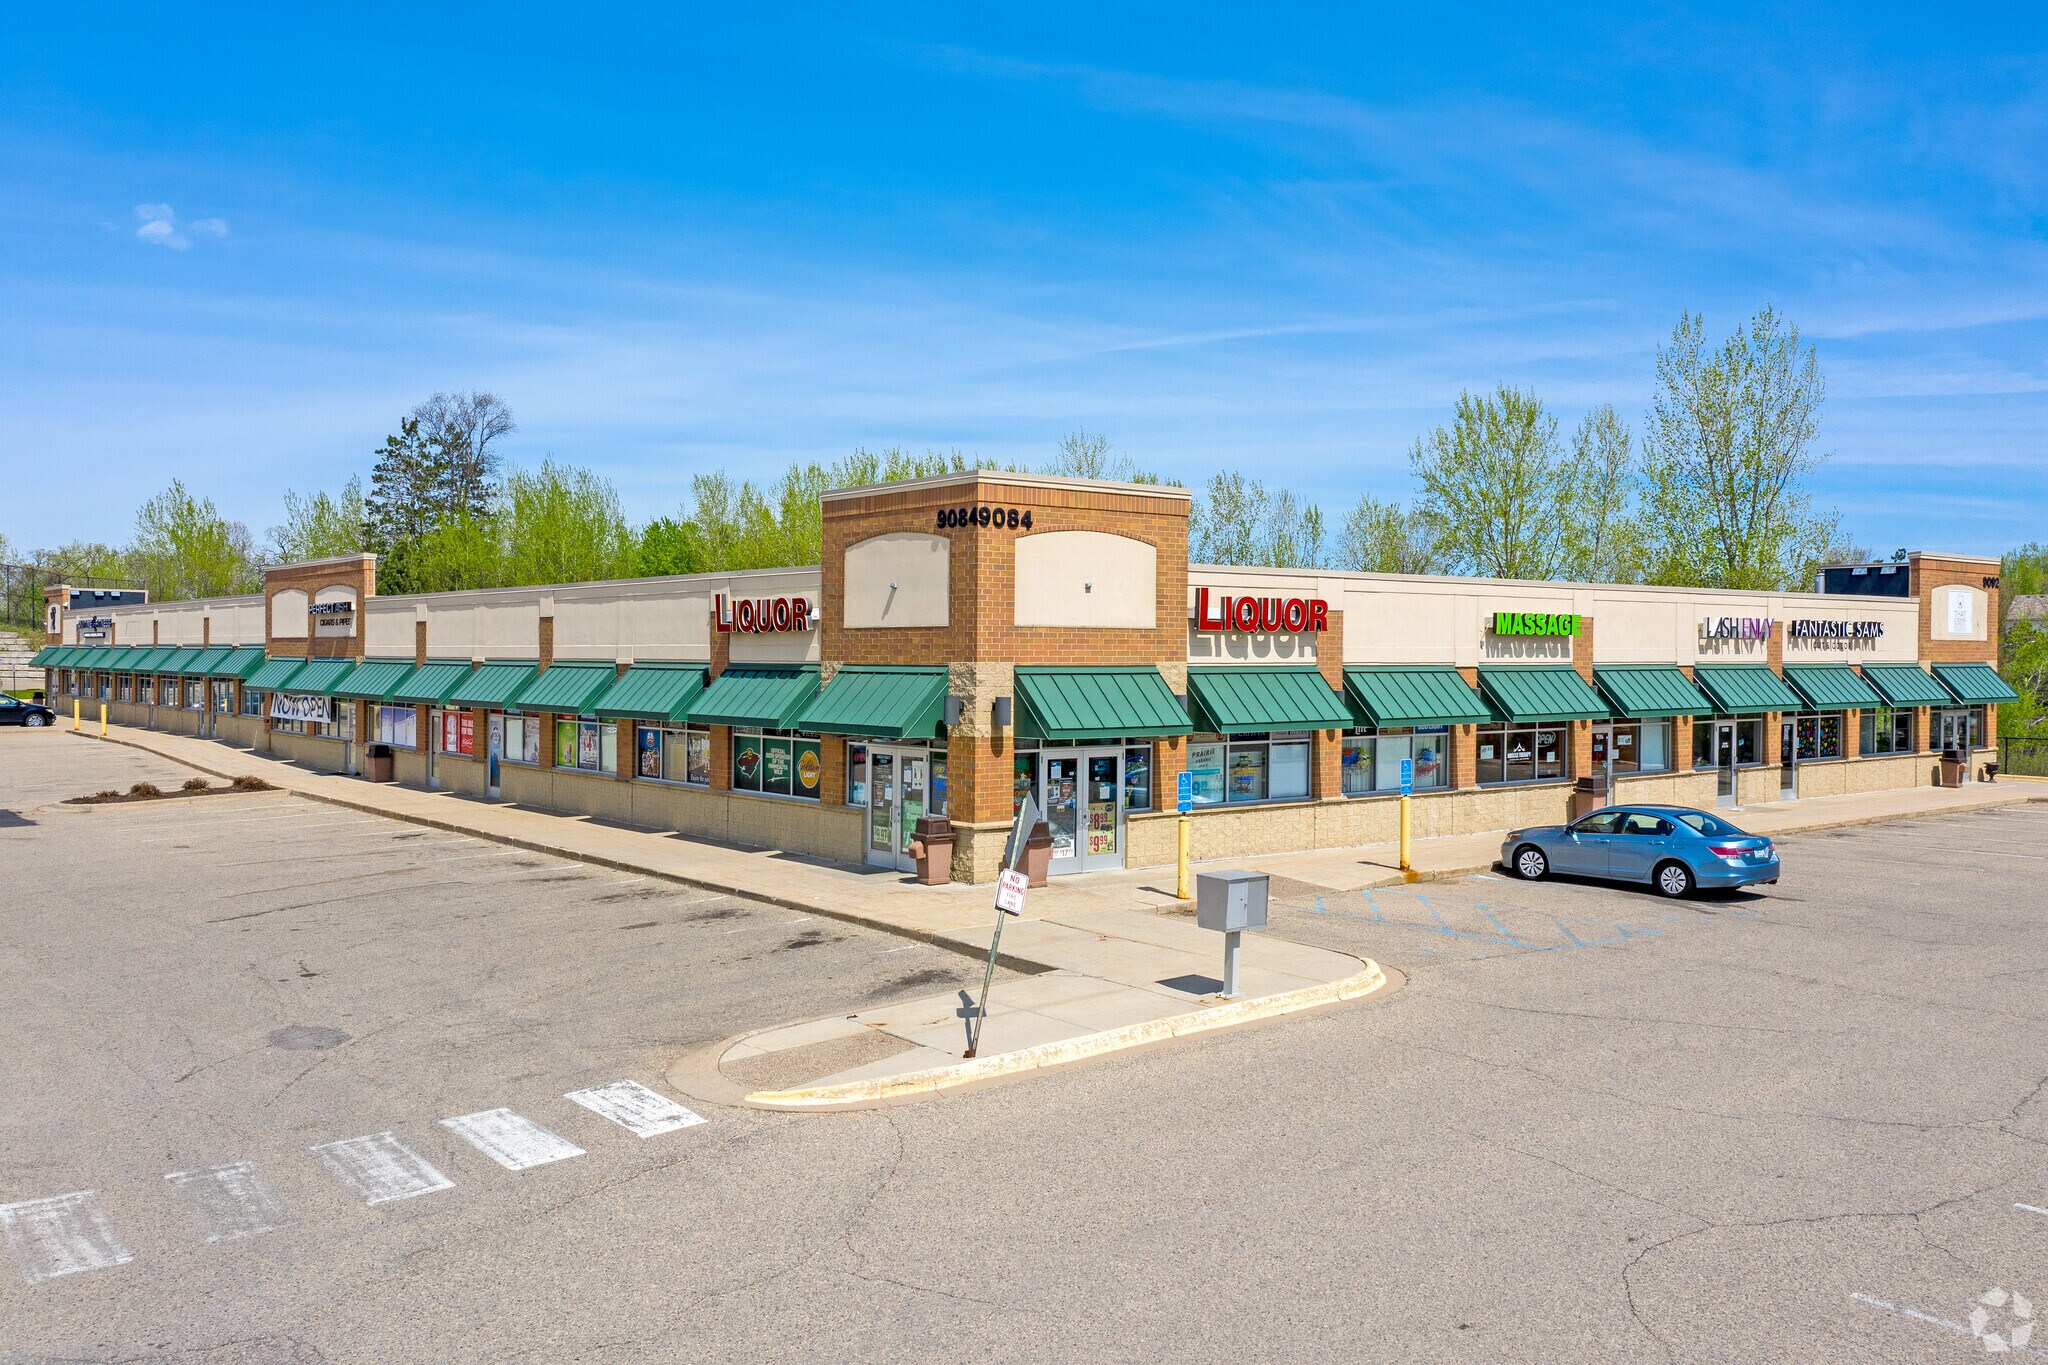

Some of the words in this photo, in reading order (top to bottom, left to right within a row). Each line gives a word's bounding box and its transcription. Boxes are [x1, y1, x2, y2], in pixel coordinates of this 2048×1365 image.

[937, 508, 978, 528] 9084
[979, 507, 1033, 531] 9084
[308, 603, 334, 614] PERFECT
[335, 602, 348, 611] ASH
[715, 594, 810, 634] LIQUOR
[1198, 588, 1329, 634] LIQUOR
[1496, 612, 1582, 636] MASSAGE
[1707, 617, 1739, 638] LASH
[1794, 620, 1853, 637] FANTASTIC
[1856, 621, 1885, 638] SAMS
[273, 693, 300, 716] NOW
[302, 696, 331, 719] OPEN
[1192, 748, 1215, 758] PRAIRIE
[797, 760, 820, 772] Golden
[1002, 881, 1024, 896] PARKING
[1010, 875, 1020, 885] NO
